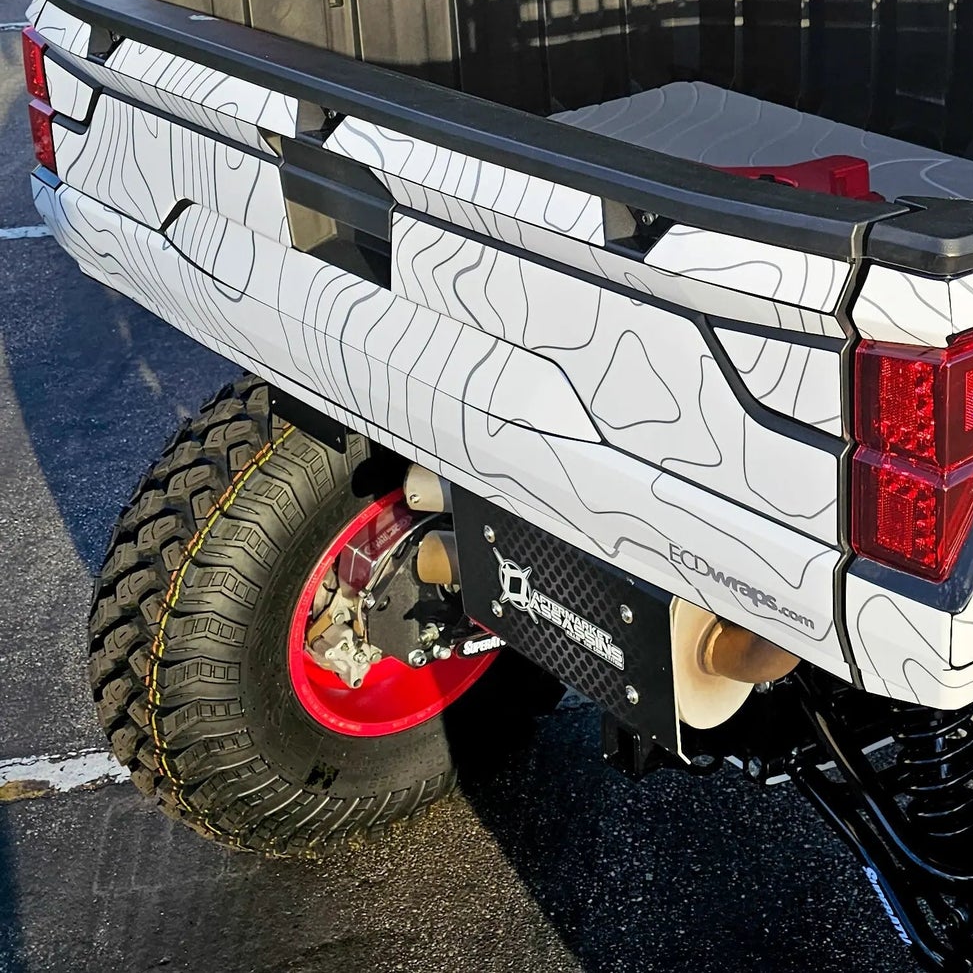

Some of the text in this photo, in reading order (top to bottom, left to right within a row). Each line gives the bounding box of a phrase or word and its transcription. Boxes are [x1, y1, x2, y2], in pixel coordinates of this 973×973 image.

[668, 542, 815, 630] ECDwraps.com
[530, 600, 623, 663] ASSASSINS
[533, 592, 612, 644] AFTERMARKET
